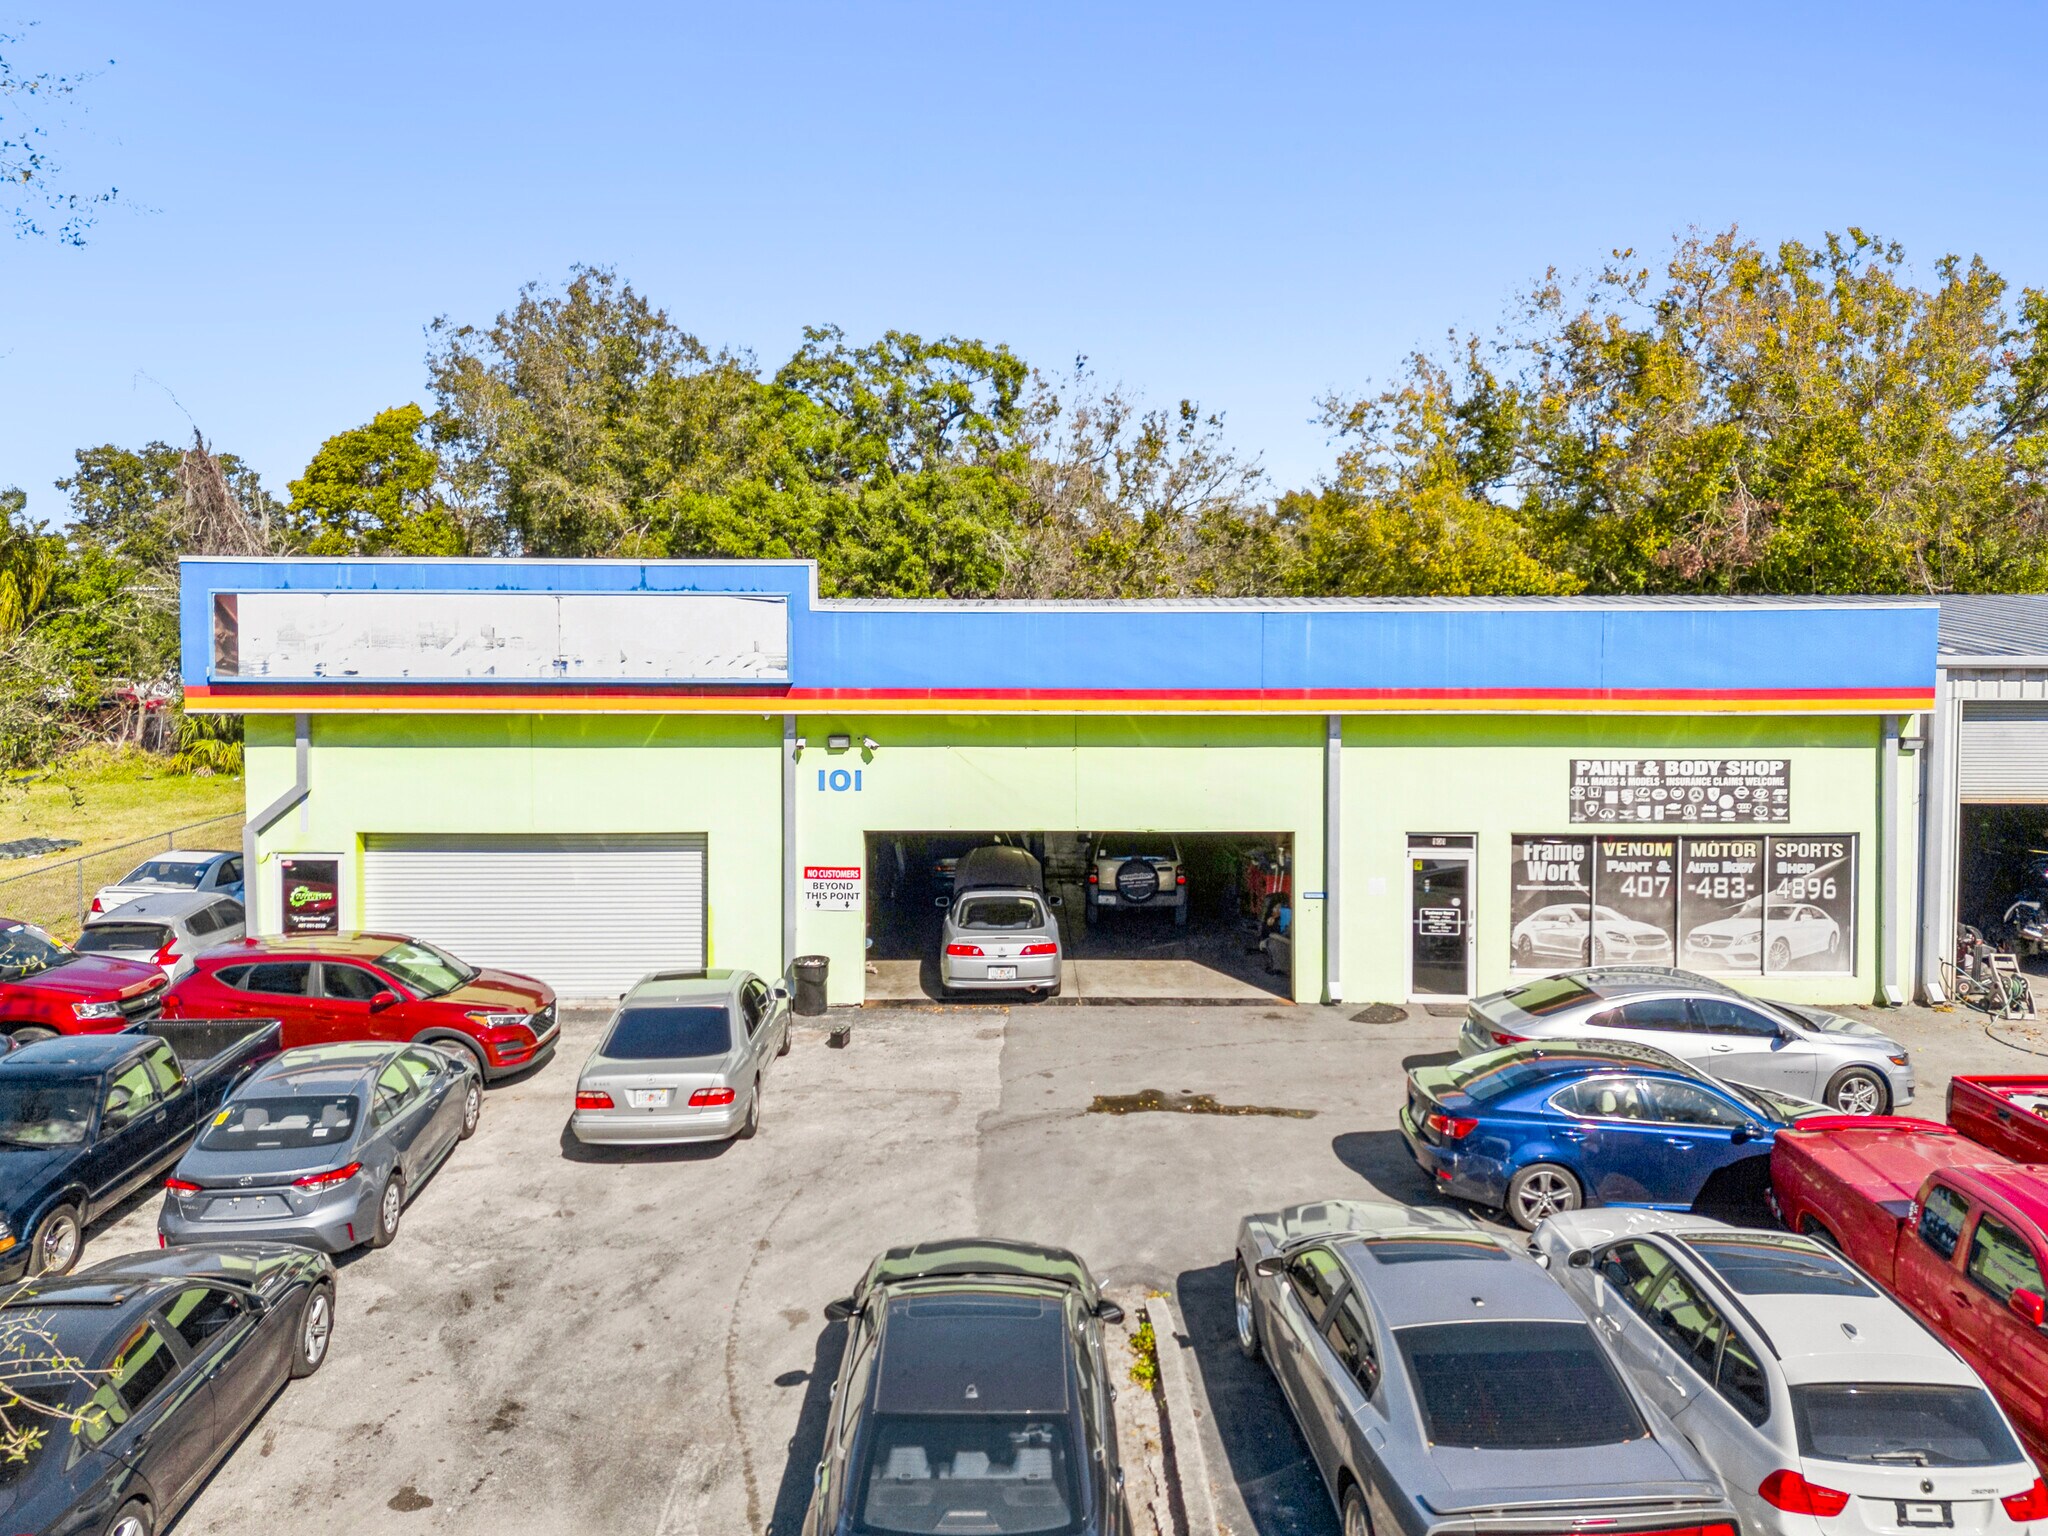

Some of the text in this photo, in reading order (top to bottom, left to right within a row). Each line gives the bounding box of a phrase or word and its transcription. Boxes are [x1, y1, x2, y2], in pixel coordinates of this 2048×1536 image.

[1576, 760, 1784, 776] PAINT & BODY SHOP
[1575, 777, 1784, 787] ALL MAKES & MODELS INSURANCE CLAIMS WELCOME
[1523, 841, 1585, 861] Frame
[1602, 842, 1844, 858] VENOM MOTOR SPORTS
[807, 869, 859, 878] NO CUSTOMERS
[1527, 861, 1580, 881] Work
[1606, 860, 1816, 874] PAINT & AUTO BODY SHOP
[812, 882, 854, 890] BEYOND
[1620, 876, 1671, 898] 407
[1776, 877, 1837, 899] 4896
[806, 892, 860, 900] THIS POINT
